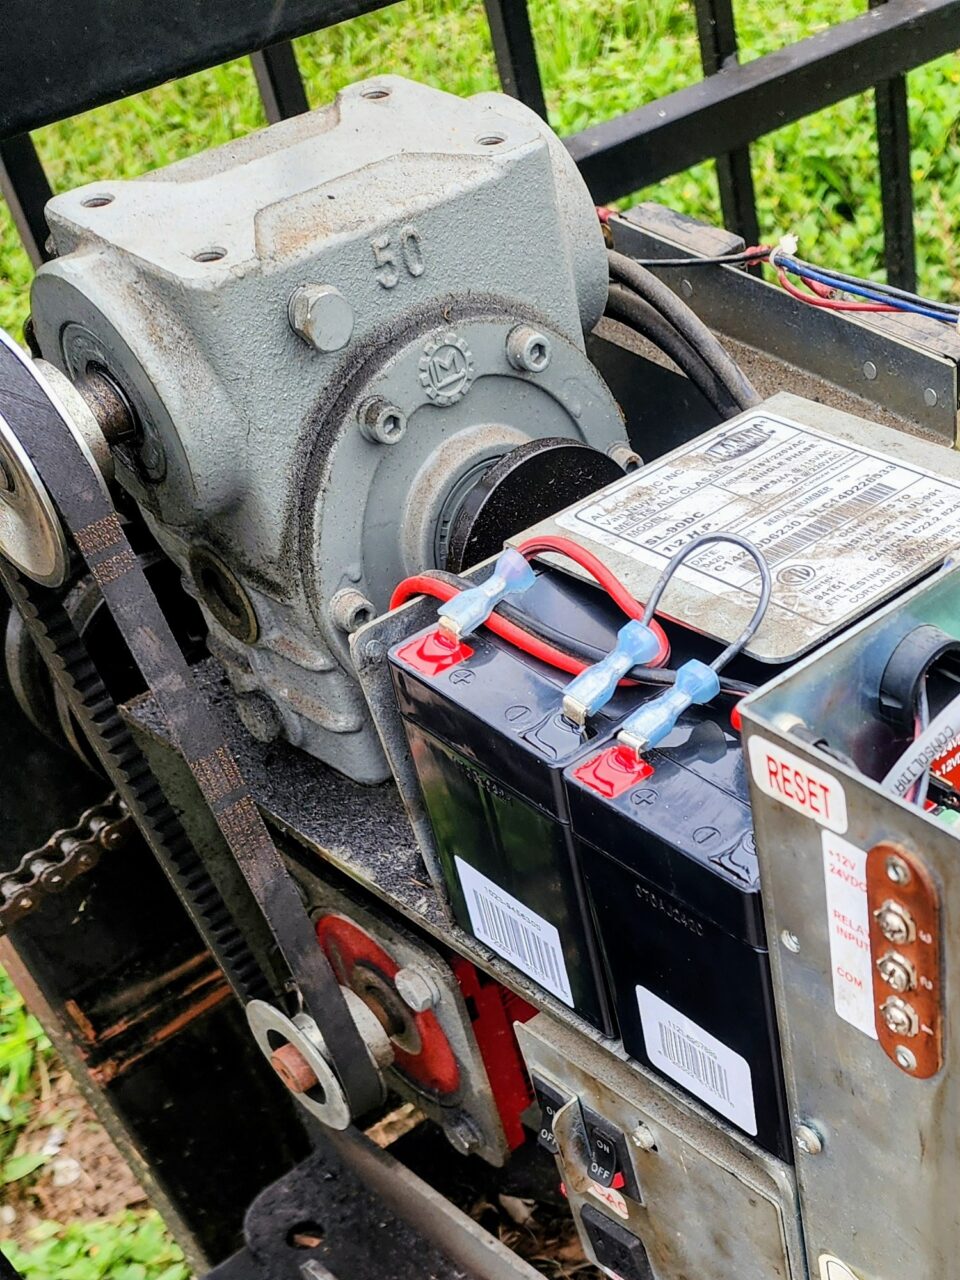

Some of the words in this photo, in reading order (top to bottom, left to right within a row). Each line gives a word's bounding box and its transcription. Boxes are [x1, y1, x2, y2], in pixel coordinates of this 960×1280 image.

[373, 224, 424, 289] 50
[612, 507, 658, 531] MEETS
[654, 494, 682, 508] ALL
[677, 464, 735, 495] CLASSES
[843, 567, 888, 593] TESTING
[766, 754, 832, 819] RESET
[836, 963, 862, 991] COM
[596, 1139, 610, 1154] ON
[591, 1162, 610, 1179] OFF
